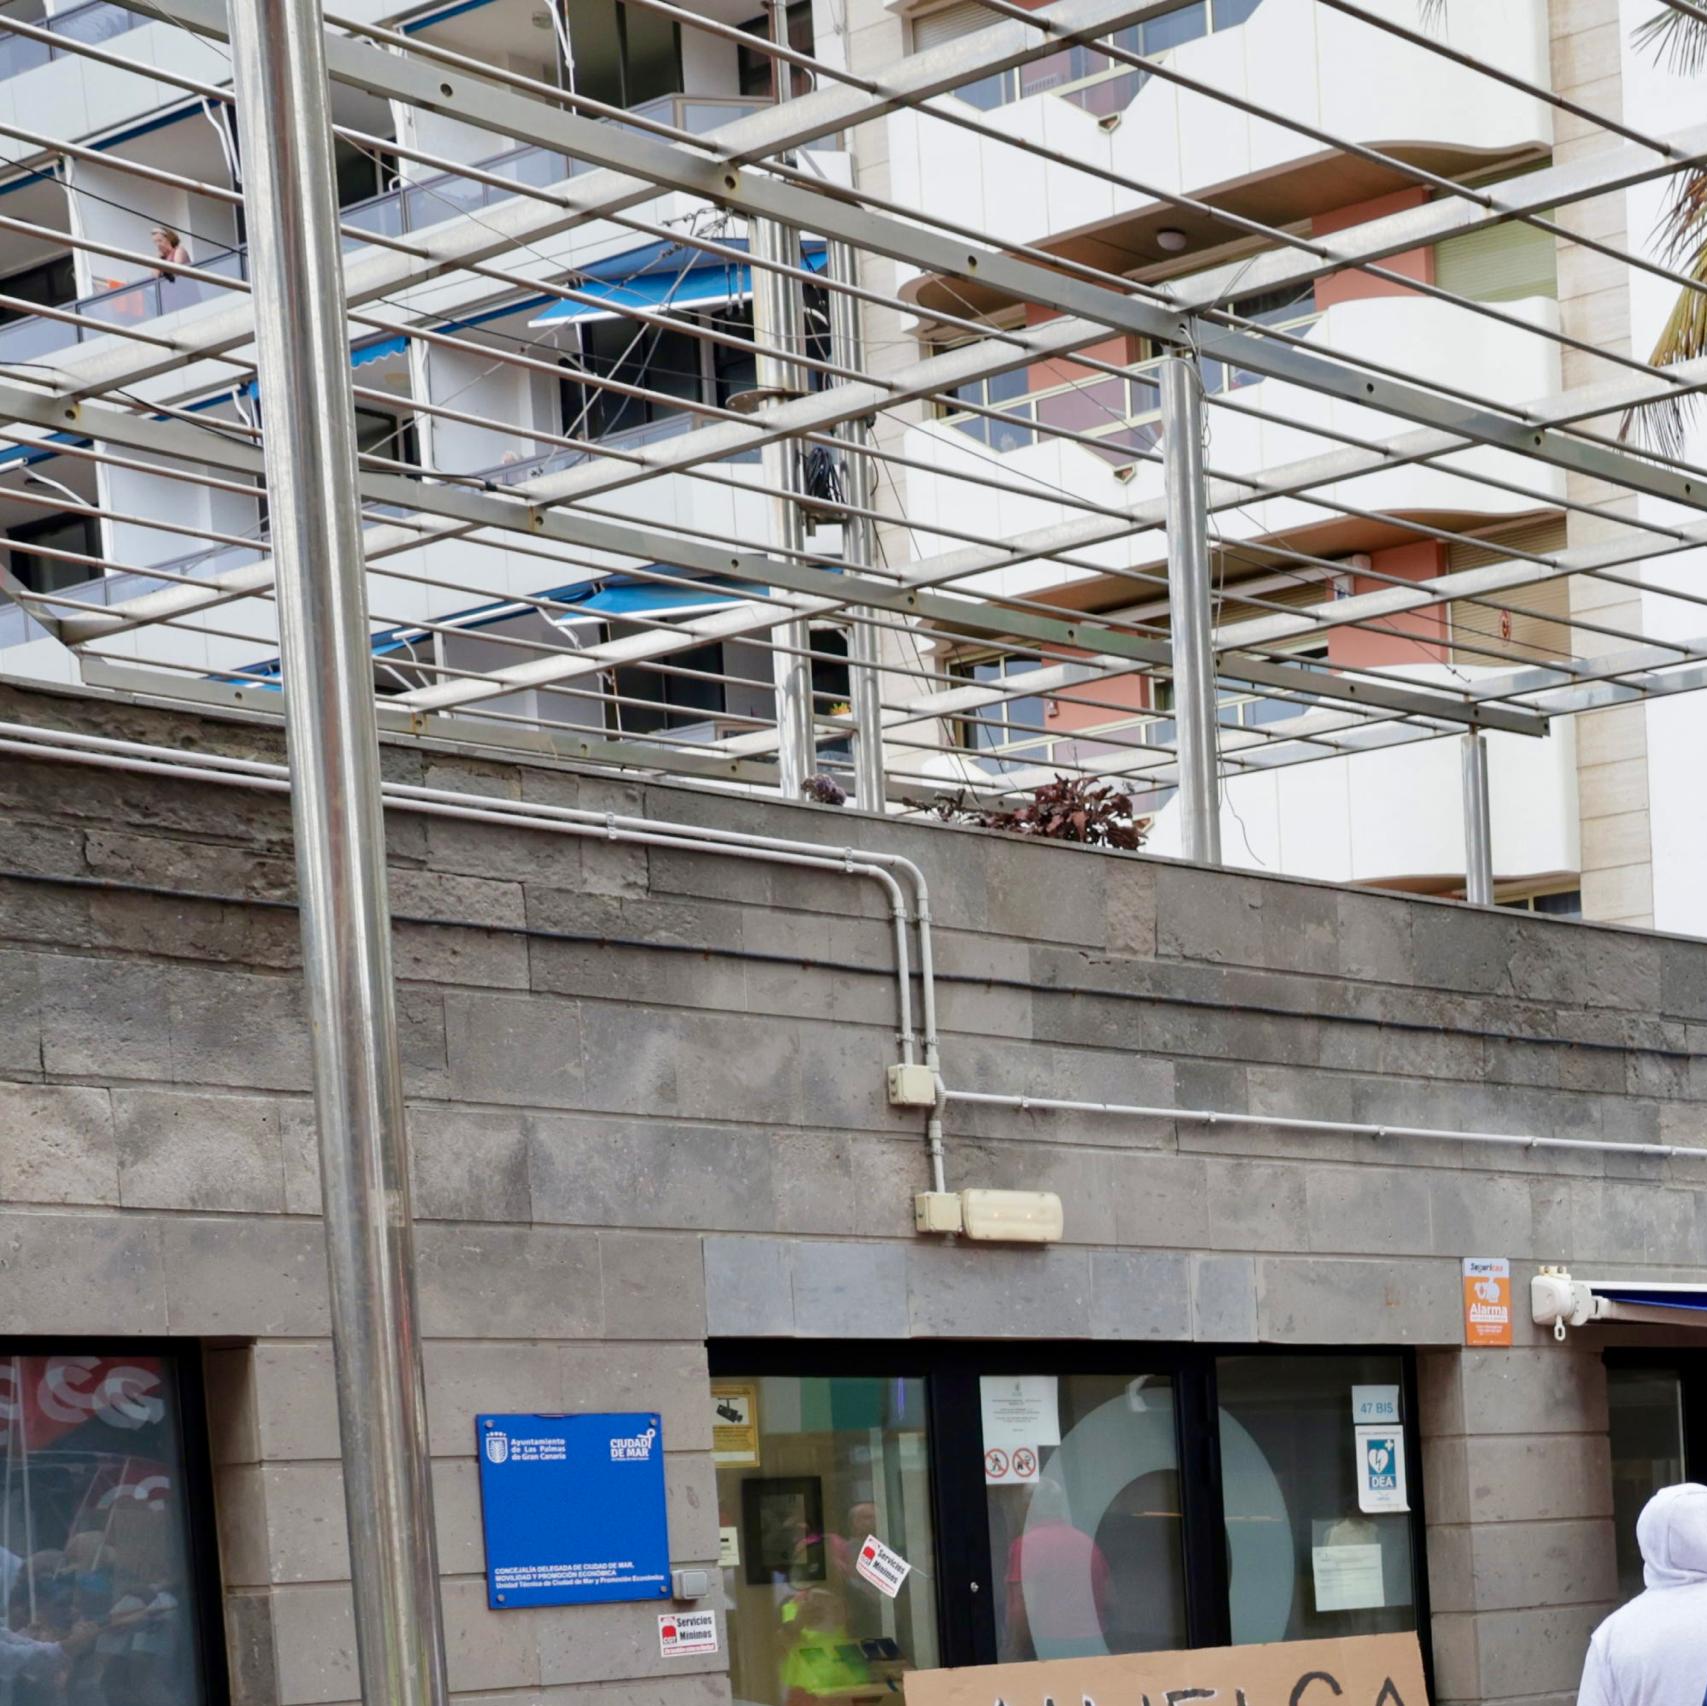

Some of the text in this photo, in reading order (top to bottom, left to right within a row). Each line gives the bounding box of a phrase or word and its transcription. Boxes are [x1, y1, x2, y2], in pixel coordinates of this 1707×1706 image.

[1471, 1303, 1508, 1317] Alarma
[1360, 1402, 1373, 1414] 47
[510, 1438, 566, 1448] Ayuntamiento
[610, 1438, 649, 1449] CIUDAD
[521, 1453, 539, 1461] Gran
[540, 1453, 567, 1461] Canaria
[610, 1448, 649, 1458] DE MAR
[1371, 1476, 1394, 1488] DEA
[676, 1615, 713, 1628] Servicios
